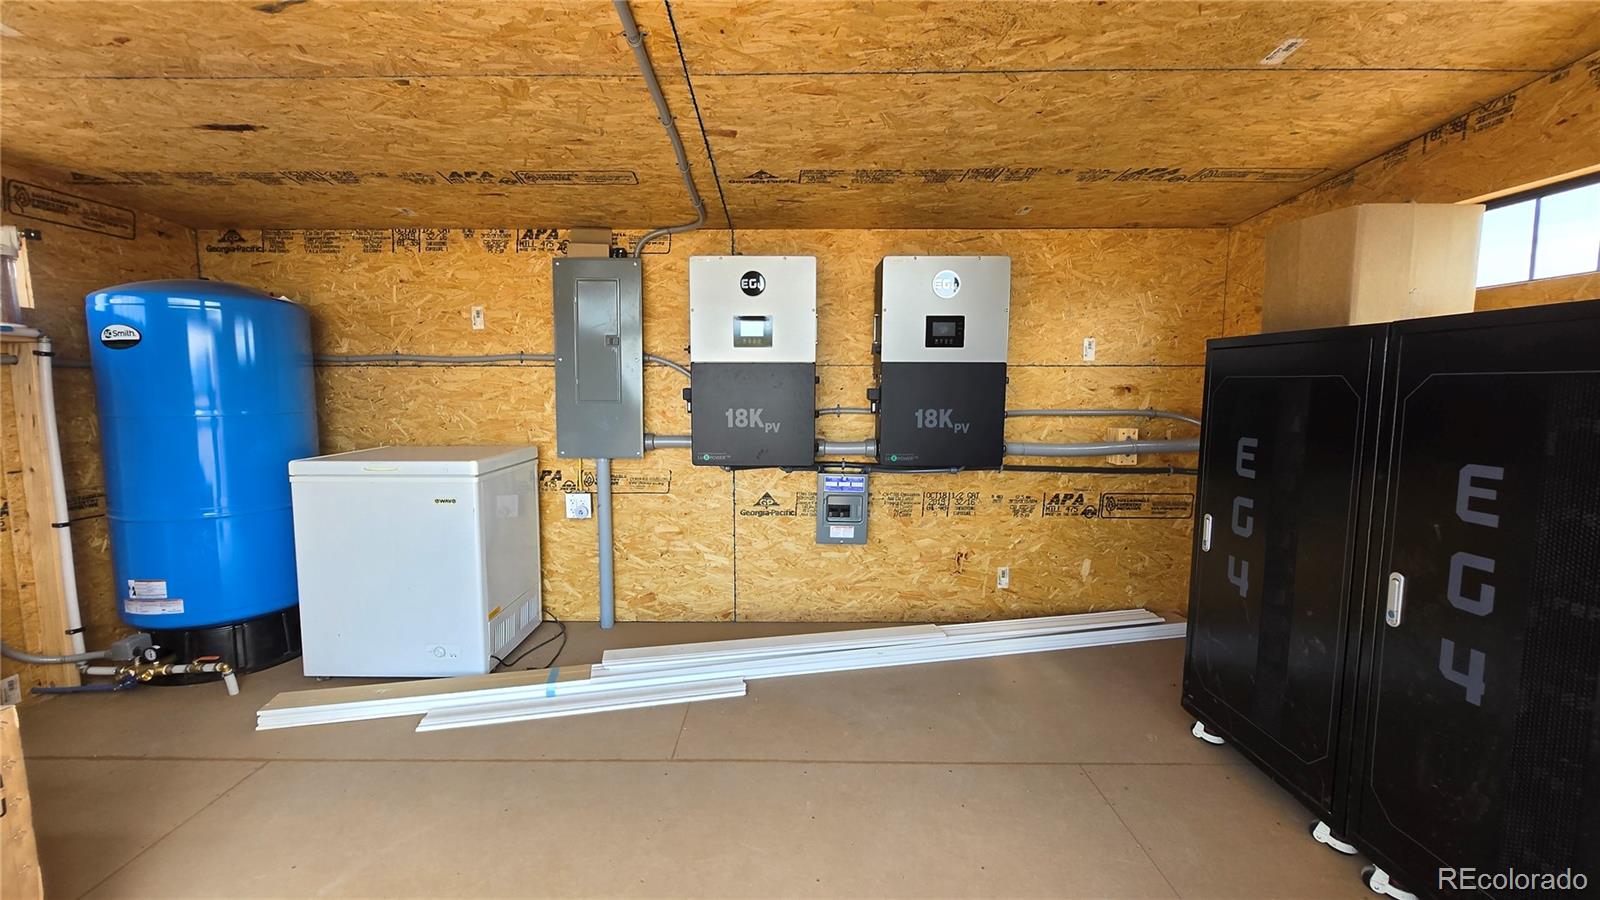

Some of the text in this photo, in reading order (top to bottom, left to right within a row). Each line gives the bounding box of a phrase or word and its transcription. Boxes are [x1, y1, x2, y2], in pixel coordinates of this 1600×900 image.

[521, 228, 559, 240] APA
[1047, 493, 1084, 505] APA
[739, 509, 796, 517] Georgia-Pacific
